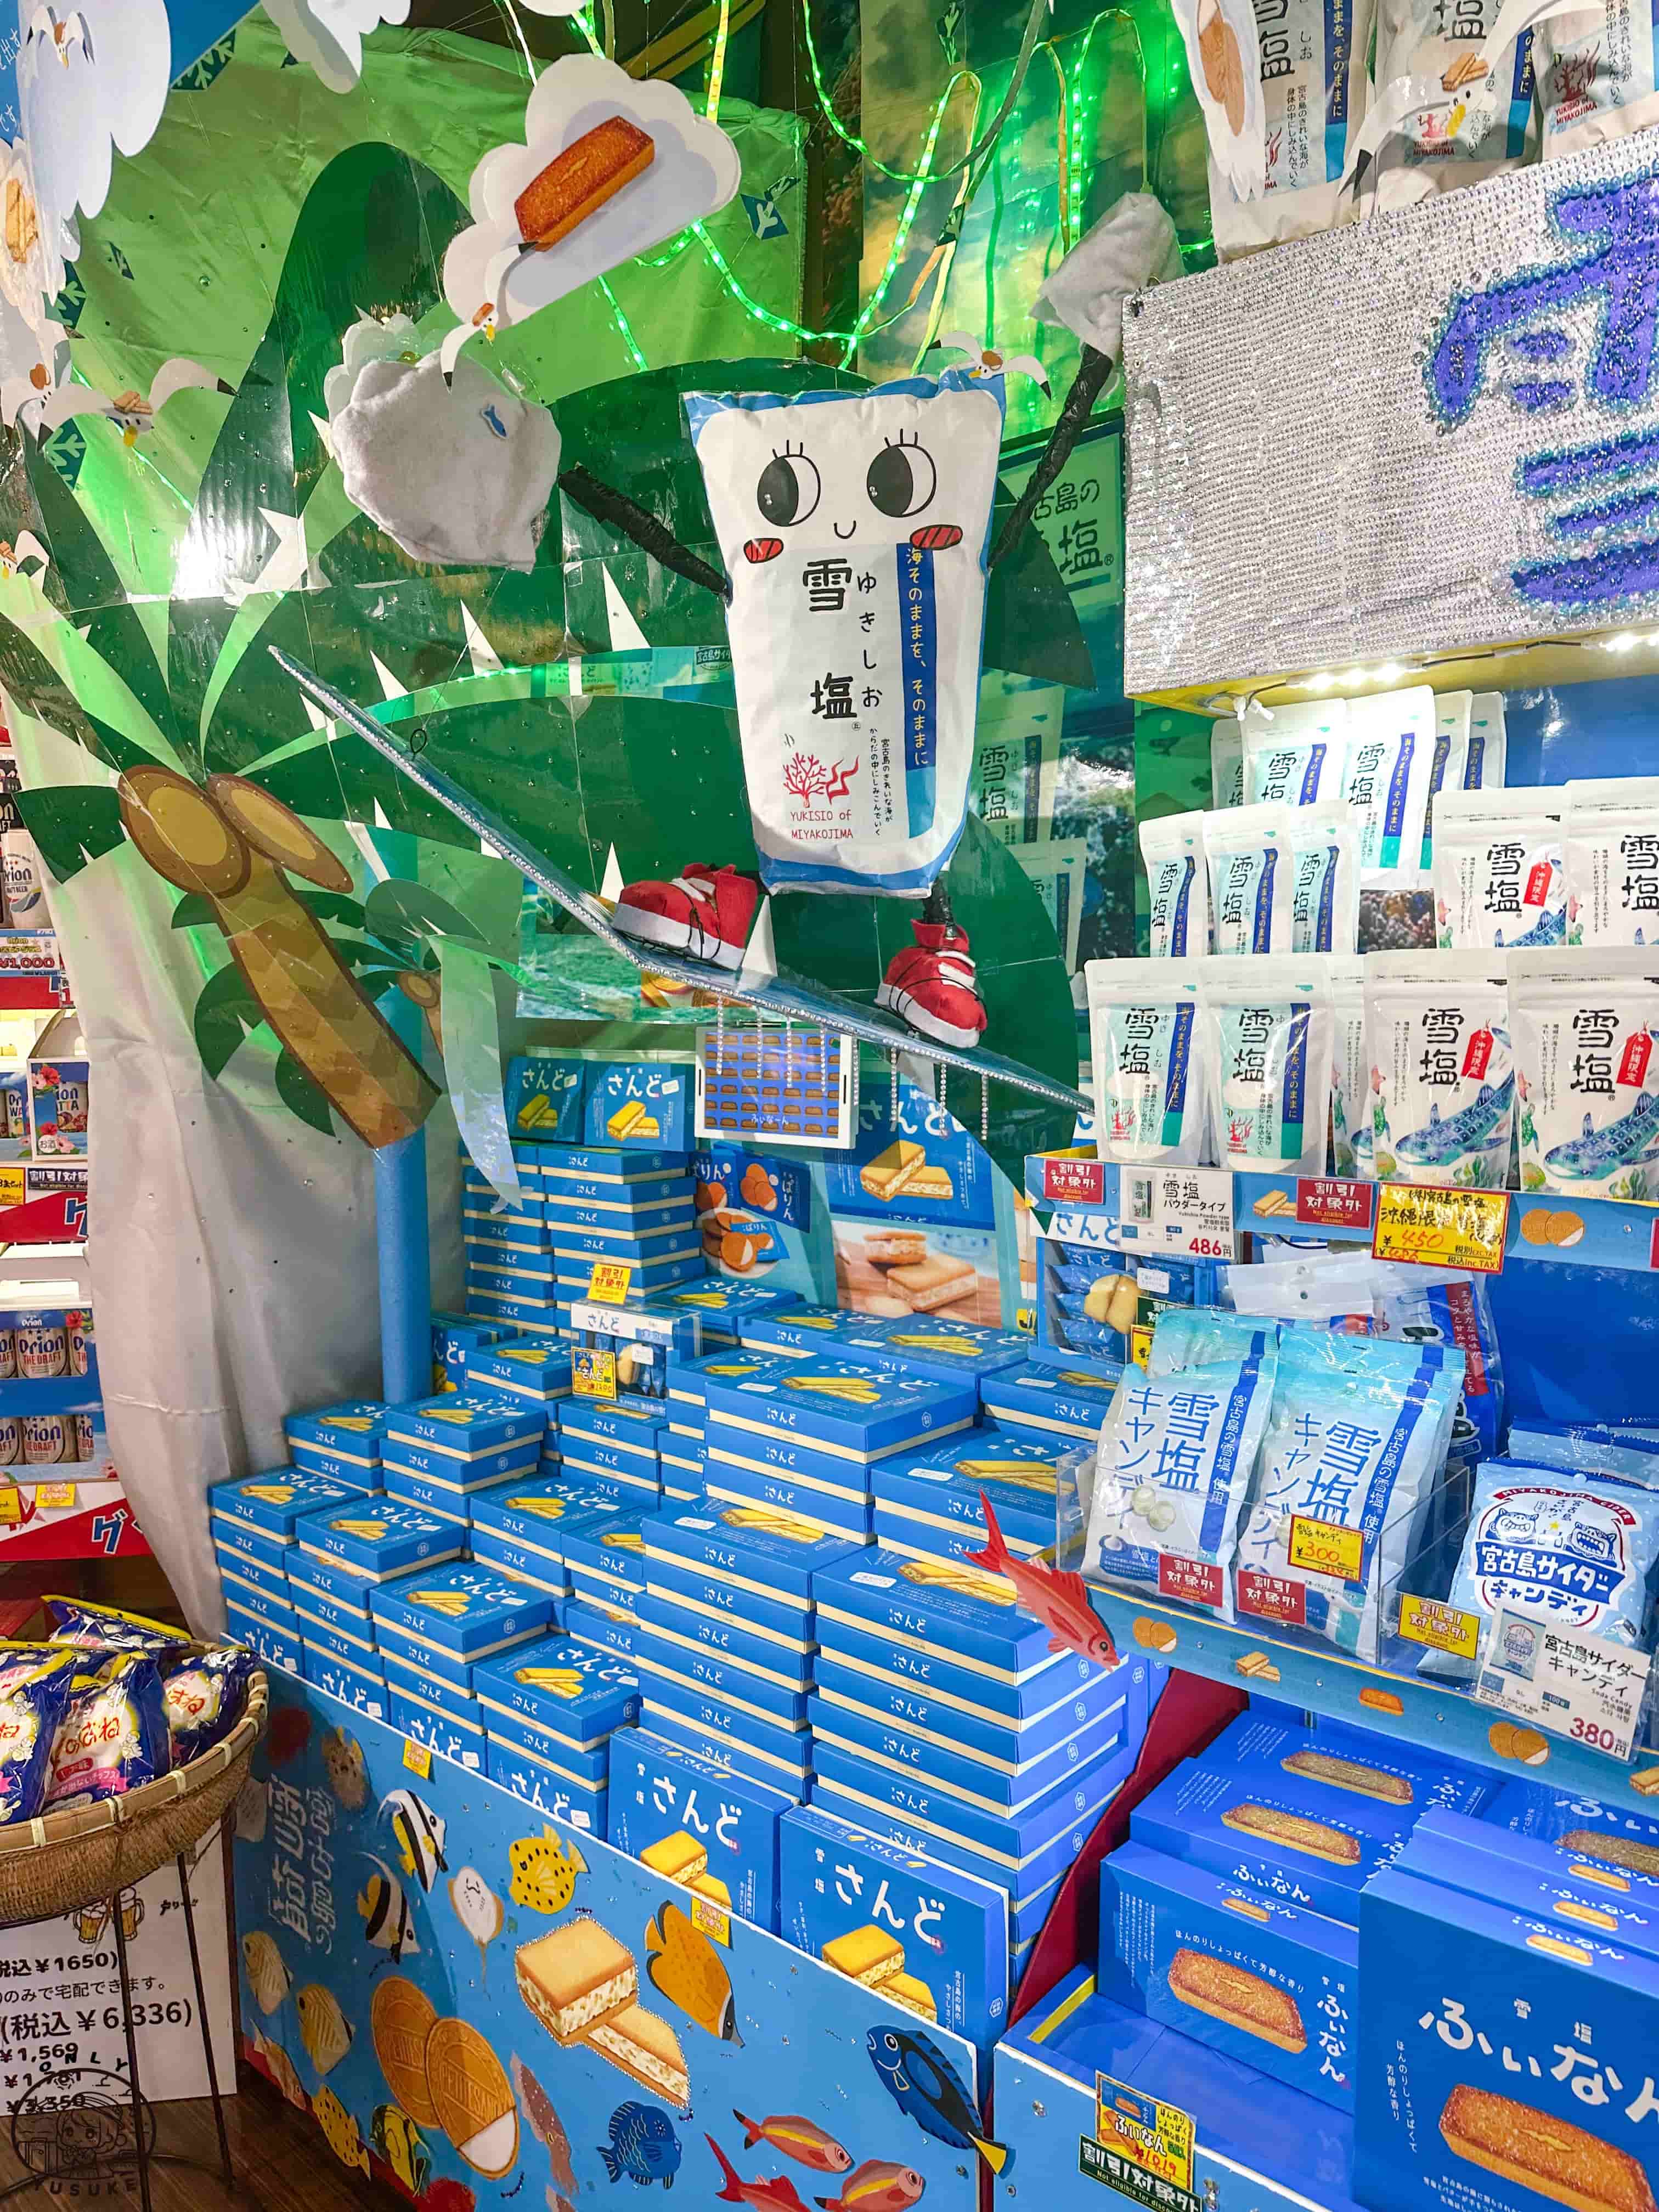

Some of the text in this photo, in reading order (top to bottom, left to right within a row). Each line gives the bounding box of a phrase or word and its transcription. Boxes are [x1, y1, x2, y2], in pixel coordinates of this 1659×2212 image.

[1606, 0, 1620, 105] 体の中にしみ込んでいく
[1619, 0, 1633, 82] 島のきれいな海が
[1556, 102, 1598, 124] MIYAKOJIMA
[802, 557, 857, 720] 雪塩
[856, 572, 883, 708] ゆきしお
[906, 547, 930, 766] 海そのままを、そのままに
[869, 727, 883, 837] からだの中にしみこんでいく
[881, 738, 894, 823] 宮古島のきれいな海が
[1348, 742, 1385, 806] 雪塩
[790, 809, 852, 822] YUKISIO of
[791, 828, 854, 840] MIYAKOJIMA
[4, 865, 32, 882] rion
[1485, 842, 1525, 913] 雪塩
[1620, 834, 1659, 911] 雪塩
[1152, 863, 1178, 926] 雪塩
[1222, 856, 1254, 924] 雪塩
[1293, 854, 1319, 922] 雪塩
[1119, 1007, 1159, 1075] 雪塩
[1233, 1008, 1274, 1083] 雪塩
[1419, 1008, 1465, 1086] 雪塩
[1570, 1009, 1620, 1094] 雪塩
[522, 1066, 566, 1092] さんど
[607, 1072, 663, 1098] さんど
[1163, 1180, 1200, 1200] 雪塩
[1164, 1200, 1226, 1212] パウダータイプ
[1402, 1229, 1444, 1248] 450
[21, 1318, 42, 1327] Orion
[19, 1333, 64, 1355] Orion
[23, 1352, 62, 1365] THE DRAFT
[770, 1408, 797, 1426] さんど
[1059, 1403, 1091, 1422] さんど
[1152, 1391, 1220, 1493] 雪塩
[770, 1448, 796, 1466] さんど
[768, 1486, 795, 1505] さんど
[1503, 1488, 1593, 1501] MIYAKOJIMA
[708, 1549, 736, 1567] さんど
[1305, 1541, 1340, 1563] 300
[602, 1556, 624, 1573] さんど
[1174, 1559, 1209, 1578] 割引
[1481, 1545, 1610, 1593] 宮古島サイダー
[1166, 1571, 1216, 1590] 対象外
[1252, 1575, 1290, 1592] 割引
[612, 1589, 634, 1606] さんど
[708, 1588, 734, 1607] さんど
[1245, 1587, 1298, 1609] 対象外
[1491, 1578, 1589, 1617] キャンディ
[894, 1610, 927, 1633] さんど
[1419, 1601, 1463, 1625] 割引
[703, 1627, 729, 1646] さんど
[1409, 1612, 1469, 1642] 対象外
[609, 1632, 631, 1650] さんど
[899, 1655, 931, 1679] さんど
[1545, 1633, 1646, 1679] 宮古島サイダー
[697, 1664, 723, 1685] さんど
[1548, 1656, 1629, 1698] キャンディ
[420, 1683, 442, 1701] さんど
[515, 1694, 538, 1713] さんど
[705, 1709, 732, 1729] さんど
[895, 1697, 928, 1721] さんど
[526, 1734, 549, 1754] さんど
[889, 1739, 921, 1763] さんど
[706, 1747, 732, 1768] さんど
[653, 1776, 743, 1849] さんど
[896, 1789, 929, 1814] さんど
[834, 1863, 946, 1947] さんど
[1175, 1929, 1306, 1994] ほんのりしょっぱくて芳醇な香り
[1386, 2063, 1401, 2122] 芳醇な香り
[1396, 2040, 1418, 2154] ほんのりしょっぱくて
[1097, 2170, 1175, 2212] Not eligible for disco
